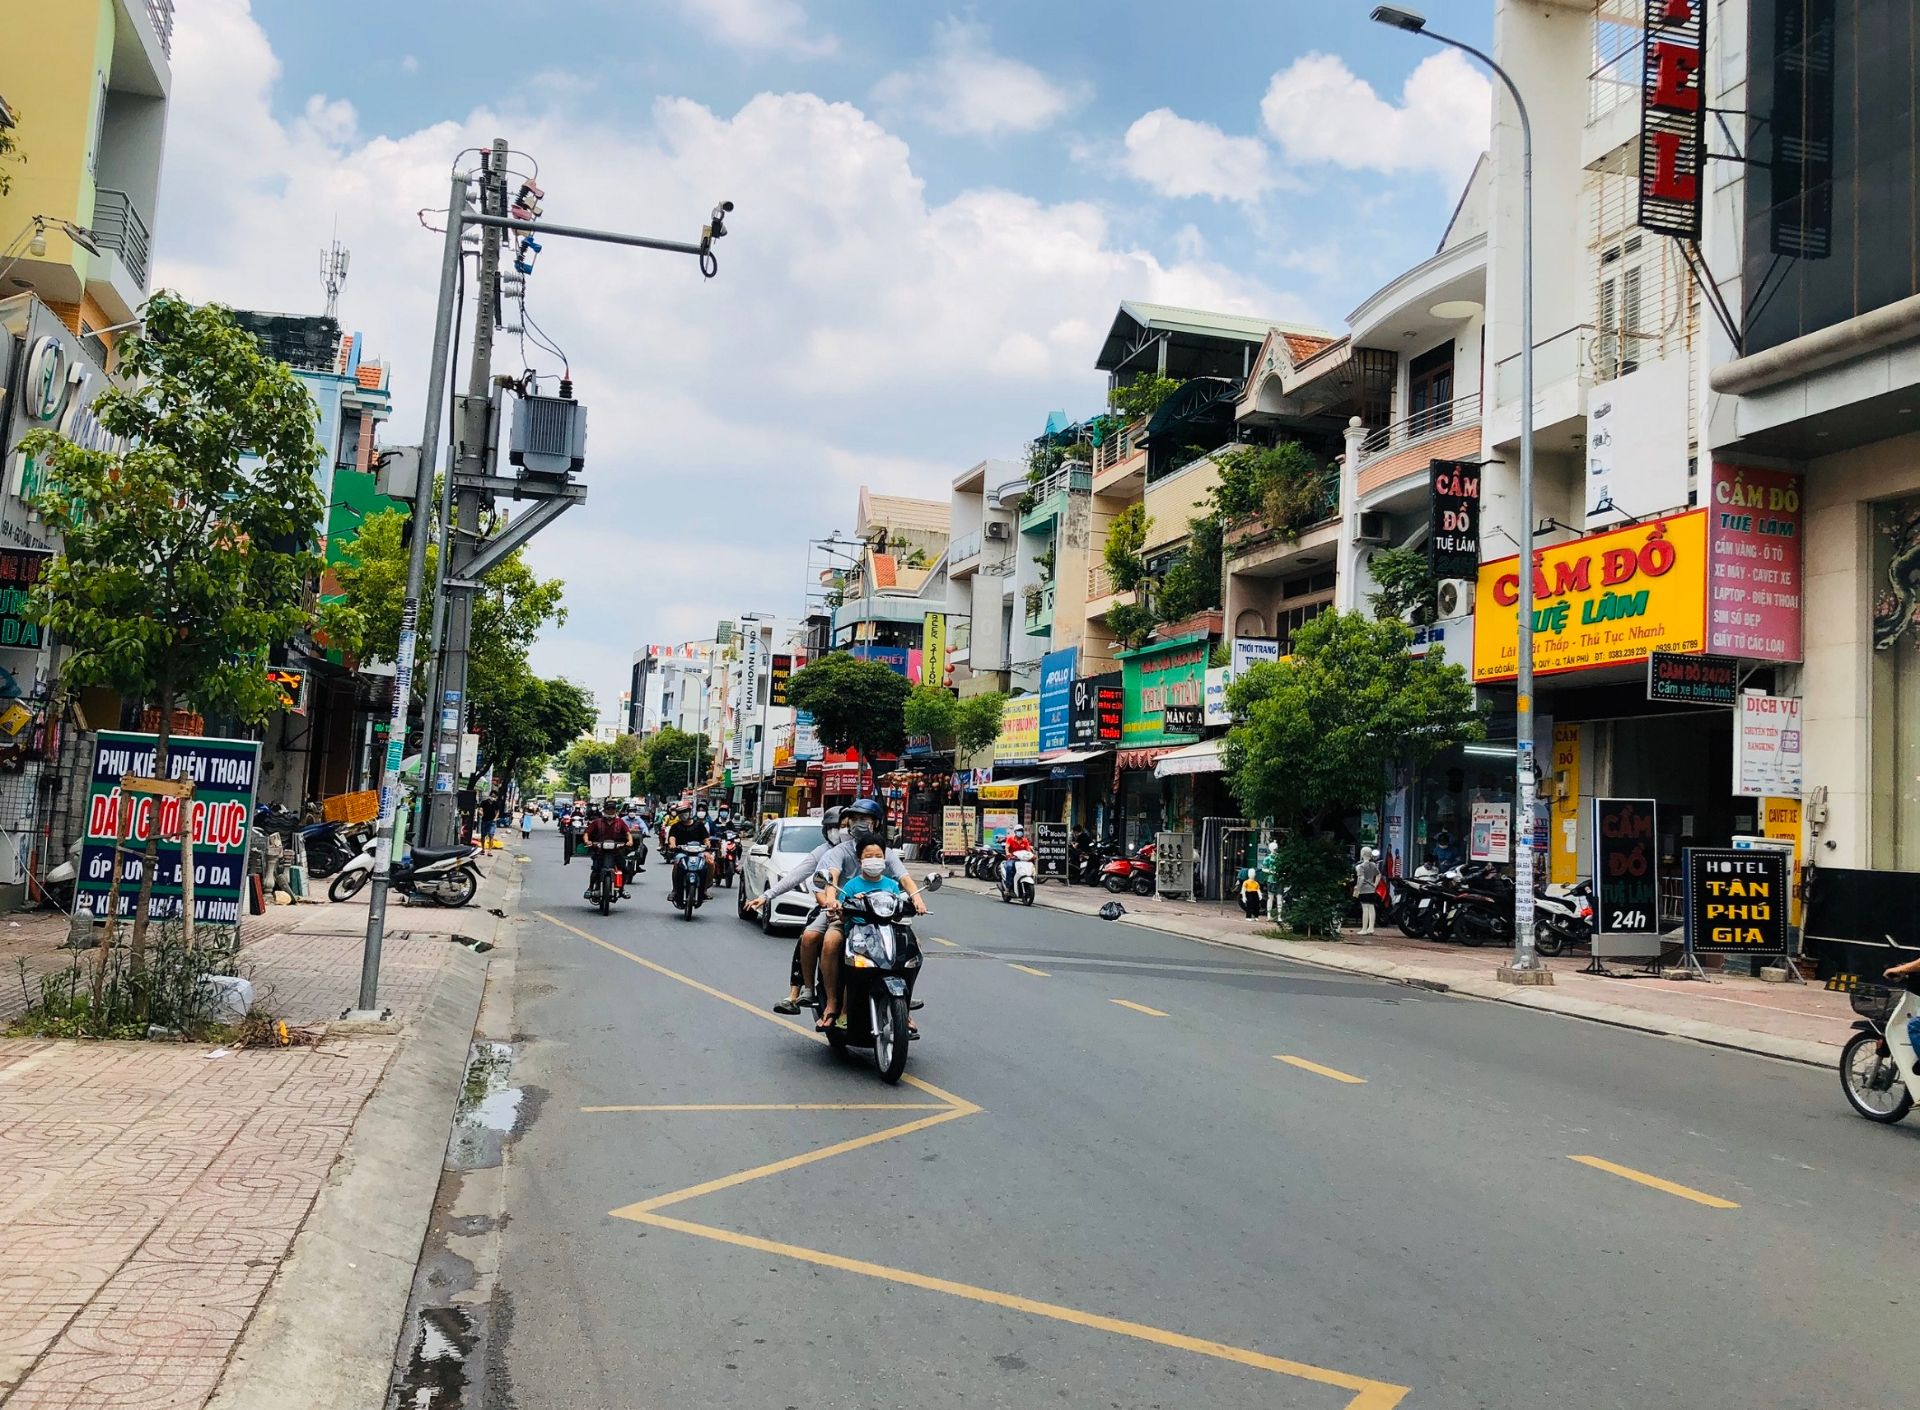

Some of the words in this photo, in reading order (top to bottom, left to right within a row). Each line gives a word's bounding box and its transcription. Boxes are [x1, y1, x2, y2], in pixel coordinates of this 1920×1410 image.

[1769, 477, 1800, 514] ĐỒ
[1442, 501, 1470, 532] ĐỒ
[1719, 512, 1753, 534] TUỆ
[1758, 516, 1796, 538] LÂM
[1436, 534, 1454, 553] TUỆ
[1456, 535, 1476, 553] LÂM
[1601, 521, 1676, 587] ĐỒ
[1734, 540, 1758, 560] VÀNG
[1771, 544, 1784, 562] TÔ
[1714, 563, 1726, 578] XE
[1727, 562, 1746, 580] MÁY
[1752, 567, 1779, 584] CAVET
[1780, 571, 1792, 586] XE
[1713, 586, 1746, 604] LAPTOP
[1752, 589, 1772, 609] ĐIỆN
[1773, 592, 1799, 613] THOẠI
[1517, 600, 1570, 635] UỆ
[1581, 590, 1650, 625] LÂM
[1713, 609, 1730, 625] SIM
[1730, 608, 1743, 626] SỐ
[1744, 612, 1762, 630] ĐẸP
[1, 618, 39, 646] DA
[1580, 631, 1600, 648] Thủ
[1604, 630, 1625, 645] Tục
[1628, 622, 1665, 640] Nhanh
[1713, 630, 1733, 648] GIẤY
[1747, 634, 1765, 652] CÁC
[1765, 638, 1786, 656] LOẠI
[1254, 645, 1277, 654] TRANG
[1563, 655, 1576, 665] TÂN
[1046, 667, 1069, 687] APOLLO
[1679, 685, 1691, 695] xe
[1186, 711, 1203, 724] CA
[1746, 697, 1777, 716] DỊCH
[1780, 699, 1799, 718] VỤ
[97, 748, 130, 782] PHỤ
[210, 757, 252, 791] THOẠI
[1768, 808, 1789, 823] CAVET
[1789, 809, 1798, 823] XE
[206, 800, 248, 854] LỰC
[89, 852, 112, 880] ỐP
[173, 863, 206, 884] BO
[210, 865, 231, 886] DA
[1706, 860, 1769, 875] HOTEL
[1705, 877, 1770, 898] TÂN
[95, 892, 130, 916] KÍH
[207, 896, 240, 921] HÌNH
[1706, 902, 1770, 921] PHÚ
[1611, 910, 1647, 929] 24h
[1712, 927, 1765, 944] GIA
